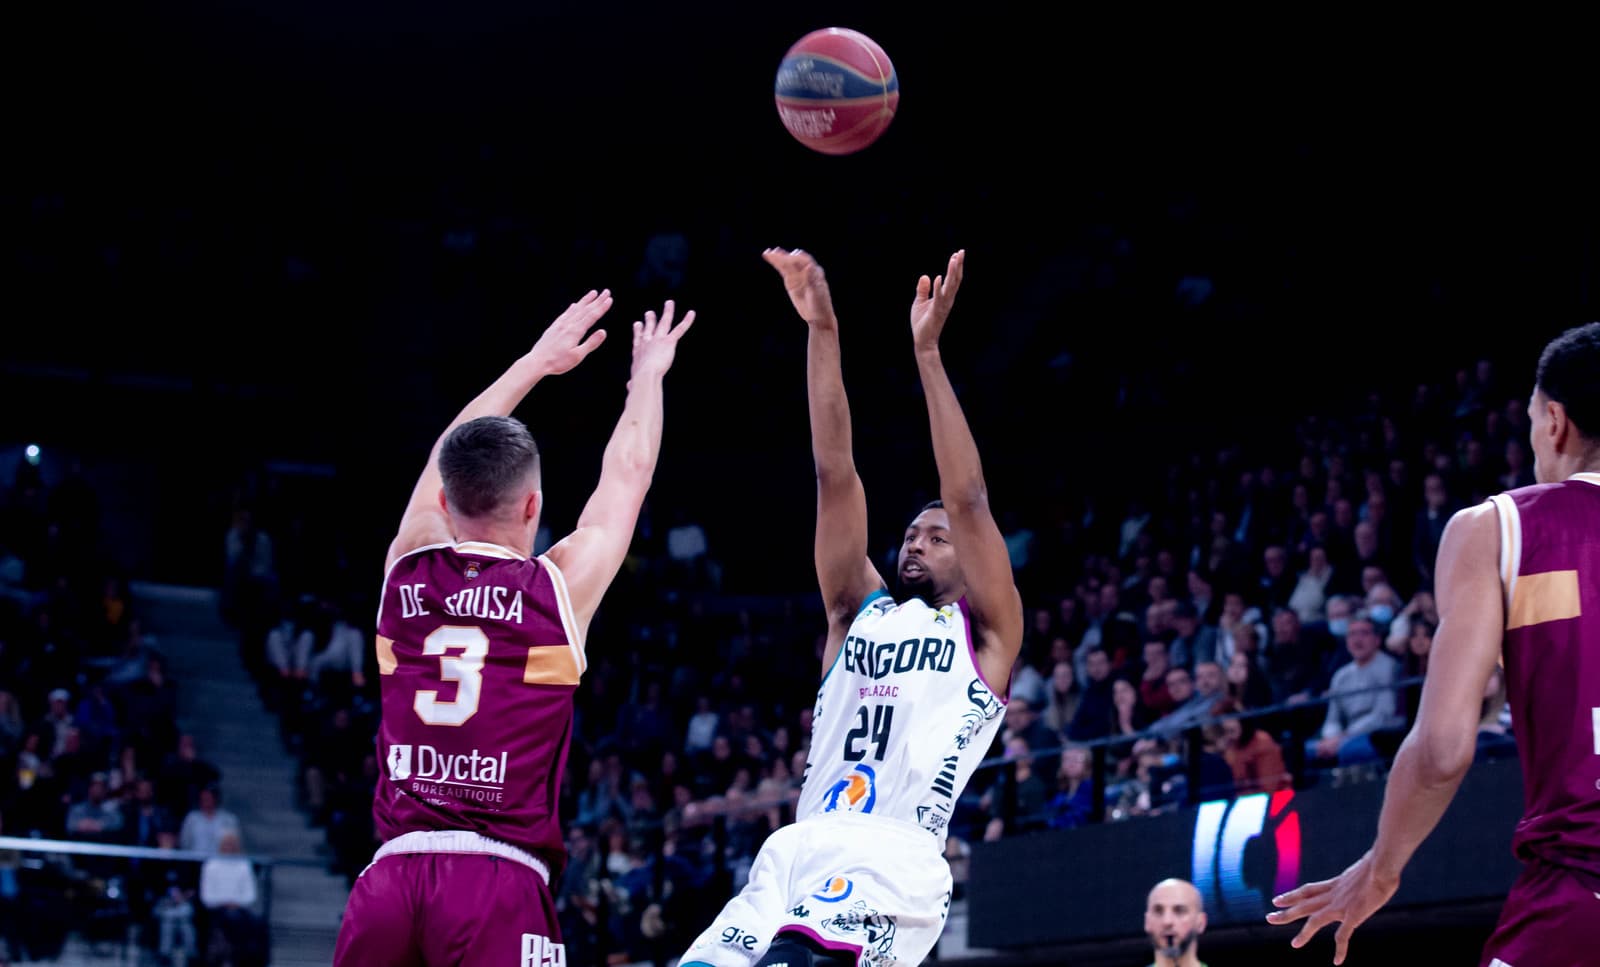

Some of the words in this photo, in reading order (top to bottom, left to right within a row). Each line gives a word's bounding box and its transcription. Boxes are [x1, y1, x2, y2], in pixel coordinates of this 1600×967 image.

[400, 584, 430, 618] DE
[445, 586, 523, 624] SOUSA
[413, 624, 490, 727] 3
[843, 705, 894, 762] 24
[418, 744, 508, 784] Dyctal
[412, 782, 504, 803] BUREAUTIQUE
[721, 926, 758, 950] gie
